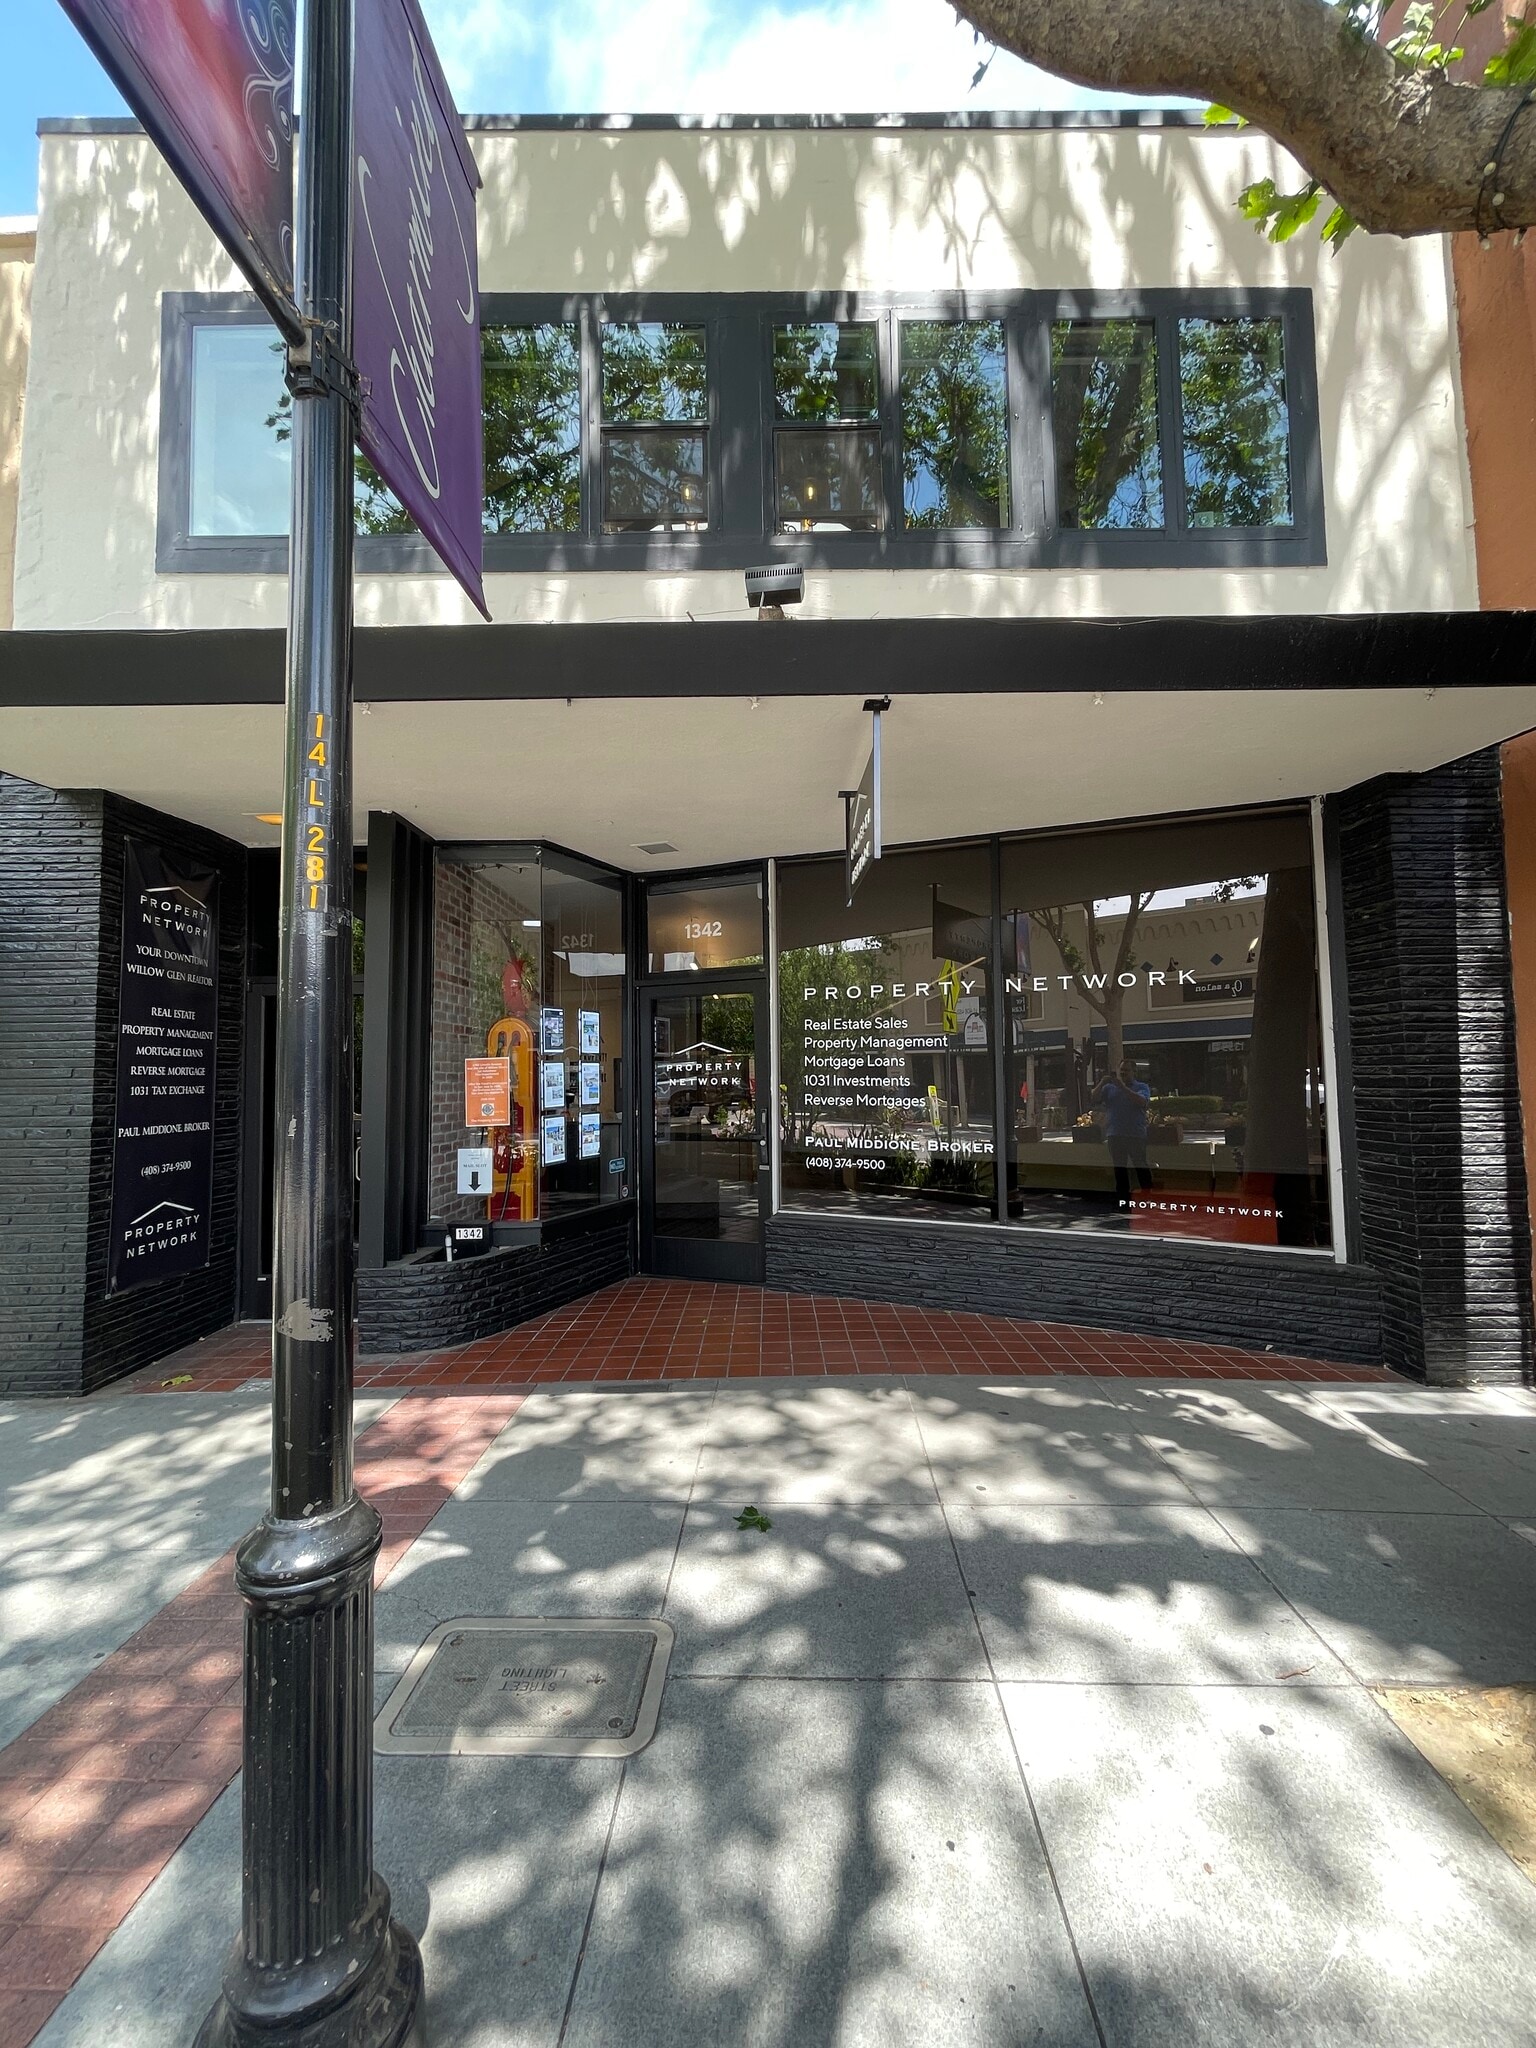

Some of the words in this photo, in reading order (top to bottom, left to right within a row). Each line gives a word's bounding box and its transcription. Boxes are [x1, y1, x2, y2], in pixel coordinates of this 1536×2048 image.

[358, 30, 475, 499] Charming
[140, 894, 210, 923] PROPERTY
[142, 913, 209, 938] NETWORK
[684, 921, 722, 939] 1342
[136, 944, 162, 958] YOUR
[164, 950, 209, 968] DOWNTOWN
[126, 963, 165, 978] WILLOW
[166, 969, 186, 982] GLEN
[187, 974, 214, 987] REALTOR
[804, 980, 976, 1001] PROPERTY
[1005, 969, 1197, 992] NETWORK
[151, 1007, 172, 1018] REAL
[174, 1009, 196, 1020] ESTATE
[122, 1024, 165, 1037] PROPERTY
[166, 1029, 214, 1040] MANAGEMENT
[804, 1019, 831, 1031] Real
[833, 1018, 873, 1030] Estate
[874, 1017, 908, 1029] Sales
[804, 1037, 857, 1051] Property
[860, 1035, 949, 1051] Management
[136, 1046, 181, 1057] MORTGAGE
[182, 1048, 203, 1058] LOANS
[666, 1062, 742, 1072] PROPERTY
[804, 1056, 864, 1070] Mortgage
[867, 1055, 906, 1067] Loans
[130, 1066, 166, 1076] REVERSE
[167, 1067, 206, 1076] MORTGAGE
[669, 1077, 741, 1086] NETWORK
[804, 1075, 830, 1087] 1031
[833, 1075, 911, 1087] Investments
[130, 1086, 149, 1096] 1031
[151, 1086, 167, 1095] TAX
[169, 1085, 206, 1095] EXCHANGE
[804, 1094, 853, 1106] Reverse
[856, 1095, 926, 1109] Mortgages
[118, 1126, 141, 1138] PAUL
[142, 1123, 184, 1136] MIDDIONE
[184, 1121, 211, 1132] BROKER
[805, 1136, 842, 1149] PAUL
[927, 1140, 995, 1154] BROKER
[141, 1165, 160, 1177] (408)
[161, 1161, 192, 1174] 374-9500
[805, 1157, 833, 1169] (408)
[834, 1158, 886, 1170] 374-9500
[1119, 1200, 1197, 1213] PROPERTY
[1206, 1205, 1284, 1218] NETWORK
[124, 1214, 200, 1241] PROPERTY
[457, 1228, 483, 1240] 1342
[126, 1231, 197, 1259] NETWORK
[501, 1667, 567, 1679] LIGHTING
[498, 1681, 557, 1692] STREET
